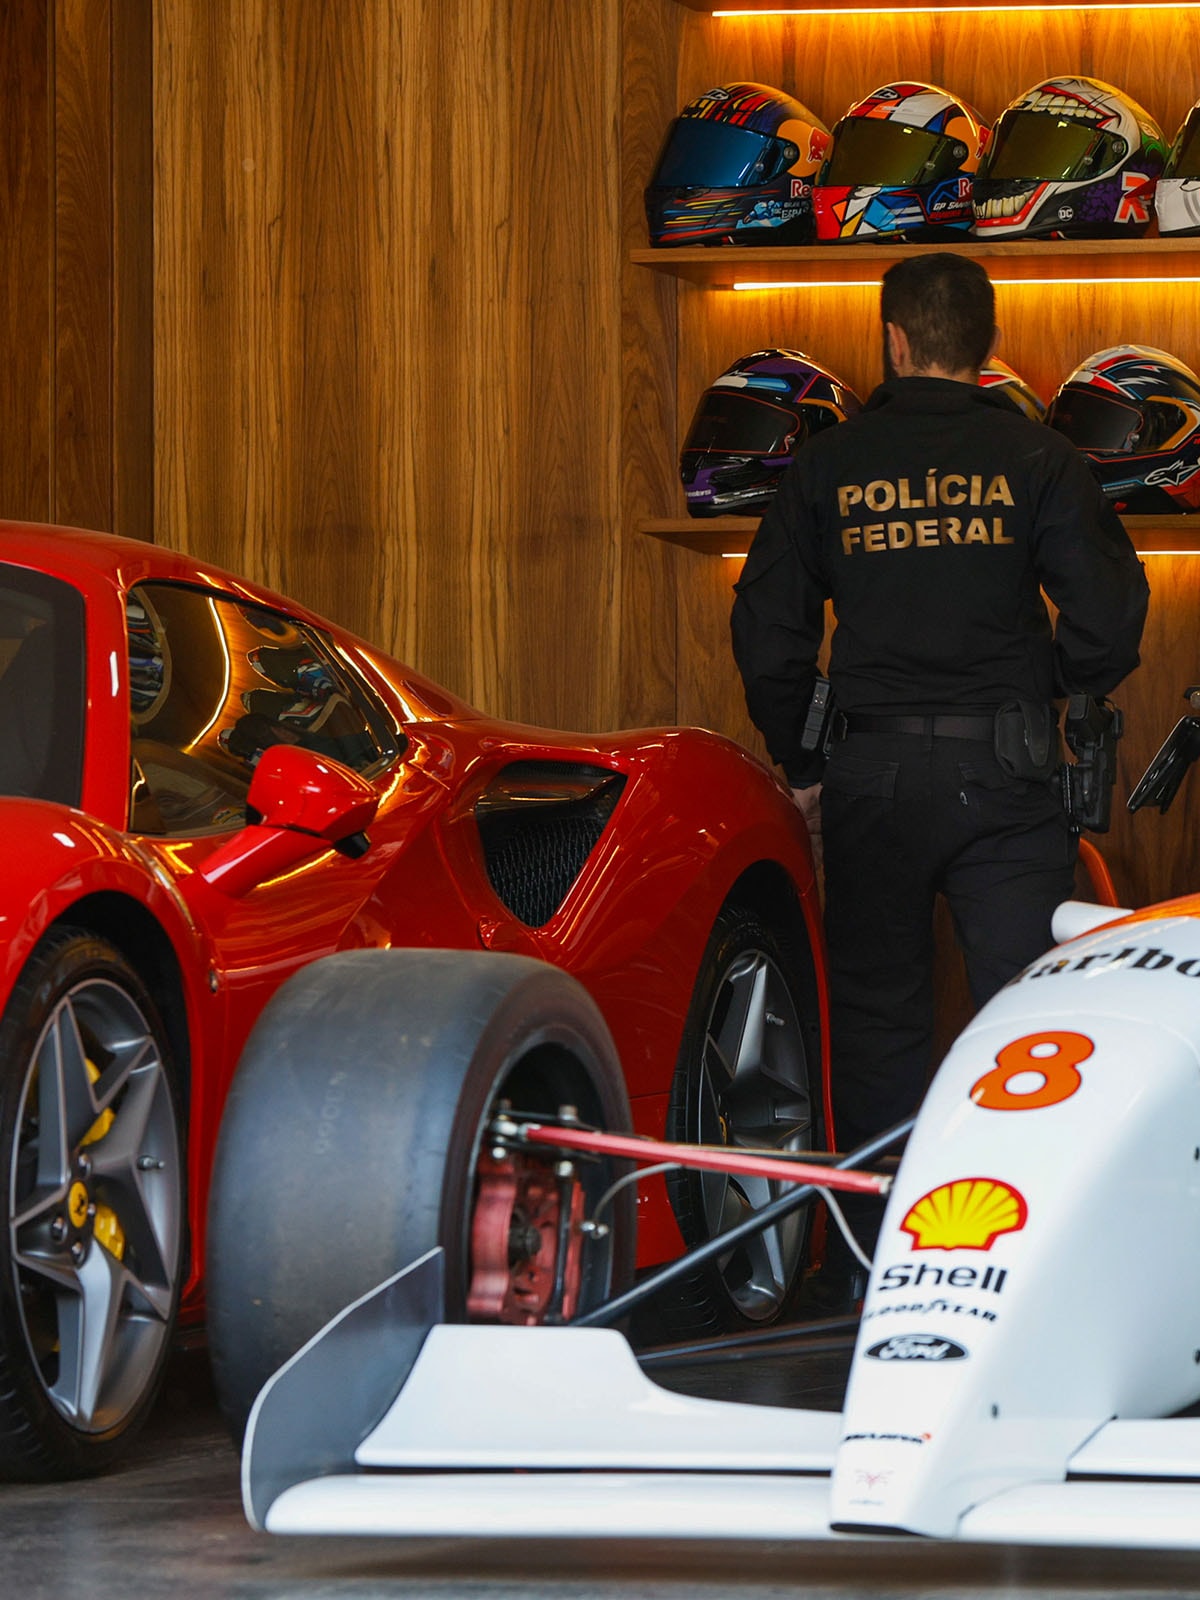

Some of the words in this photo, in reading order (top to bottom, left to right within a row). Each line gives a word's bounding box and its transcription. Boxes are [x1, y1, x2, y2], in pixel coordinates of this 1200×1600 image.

[1058, 208, 1074, 219] DC
[837, 467, 1016, 517] POLÍCIA
[841, 517, 1015, 555] FEDERAL
[969, 1031, 1095, 1111] 8
[878, 1263, 1008, 1294] Shell
[878, 1335, 951, 1361] Ford
